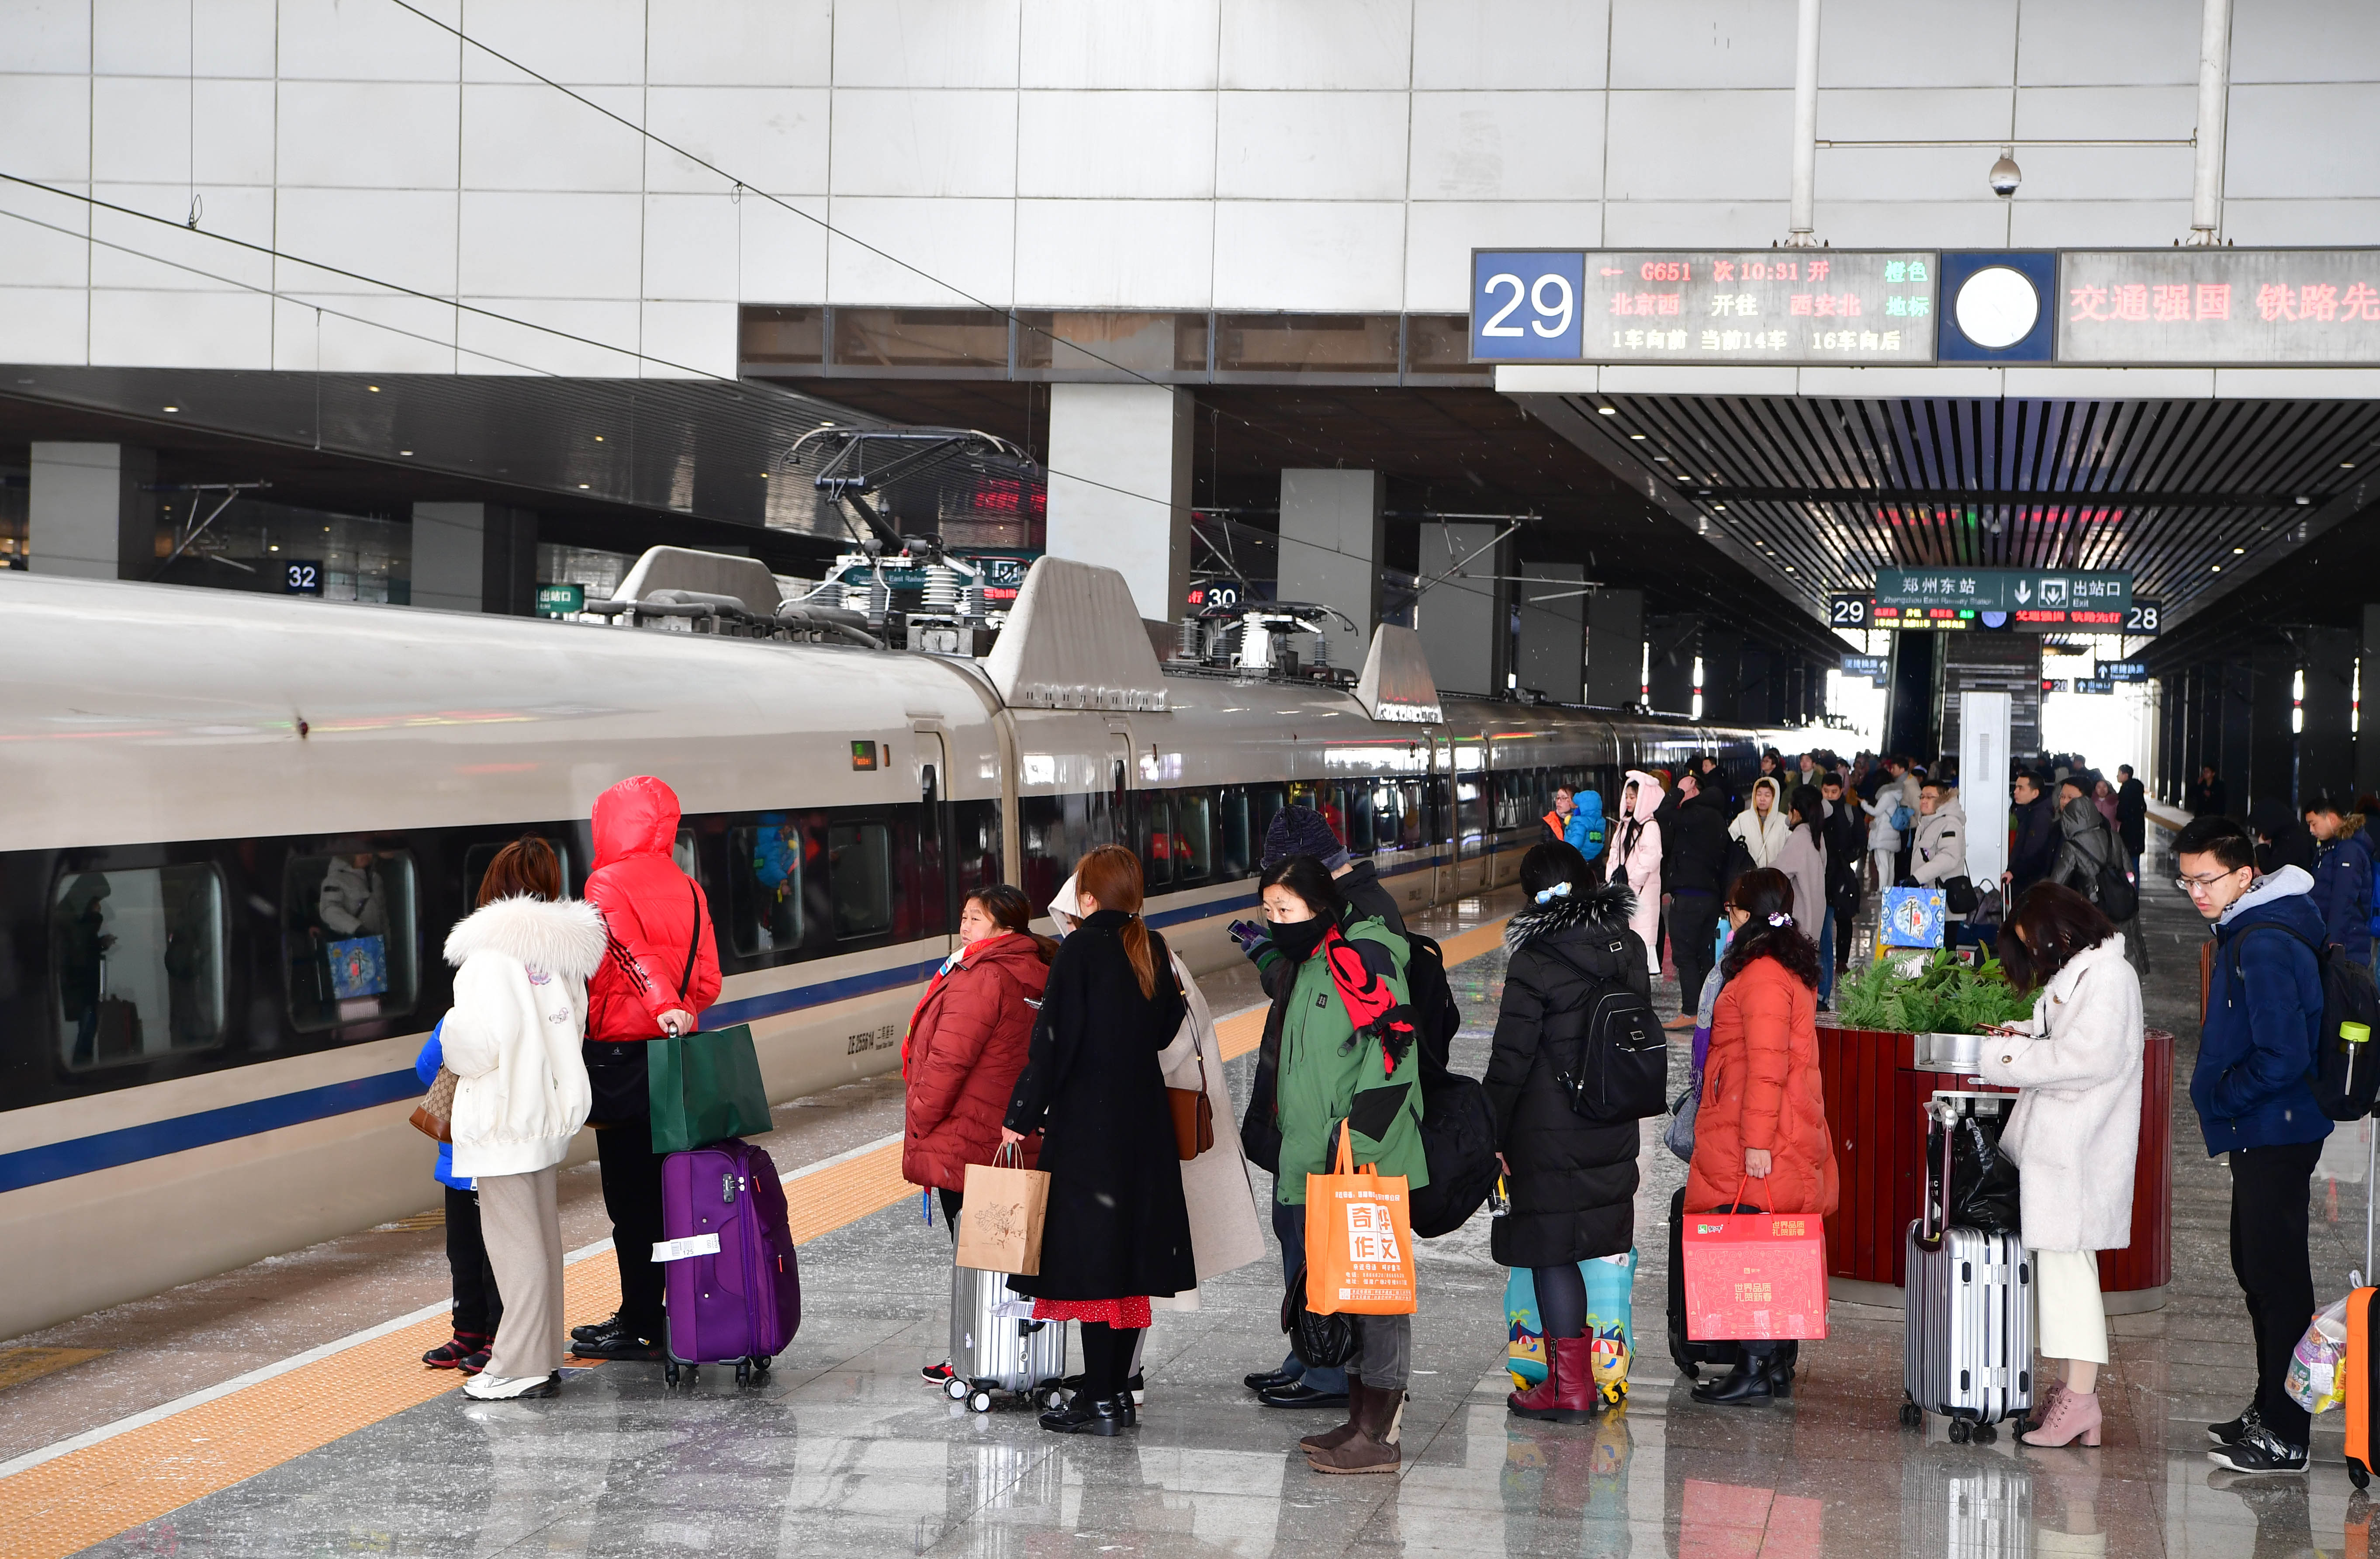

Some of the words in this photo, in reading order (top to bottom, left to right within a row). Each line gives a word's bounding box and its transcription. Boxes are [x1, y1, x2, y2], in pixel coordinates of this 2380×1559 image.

[1641, 262, 1692, 282] G651
[1713, 261, 1733, 282] 次
[1742, 263, 1798, 281] 10:31
[1808, 261, 1830, 282] 开
[1885, 260, 1928, 283] 橙色
[1481, 274, 1574, 338] 29
[1611, 293, 1680, 316] 北京西
[1711, 294, 1758, 316] 开往
[1790, 293, 1861, 317] 西安北
[1885, 296, 1929, 318] 地标
[2070, 283, 2231, 322] 交通强国
[2257, 282, 2380, 322] 铁路先
[1612, 329, 1688, 350] 1车向前
[1702, 329, 1787, 351] 当前14车
[1812, 330, 1901, 351] 16车向后
[289, 565, 315, 588] 32
[1903, 577, 1976, 595] 郑州东站
[1208, 588, 1236, 607] 30
[2073, 579, 2121, 597] 出站口
[1834, 600, 1864, 623] 29
[1883, 596, 1922, 606] Zhengzhou
[1923, 596, 1939, 605] East
[1970, 597, 1994, 605] Station
[2073, 598, 2089, 608] Exit
[2127, 607, 2158, 630] 28
[2053, 680, 2067, 692] 28
[1354, 1236, 1397, 1259] 作文
[1734, 1283, 1772, 1292] 世界品质
[1735, 1292, 1772, 1302] 礼贺新春
